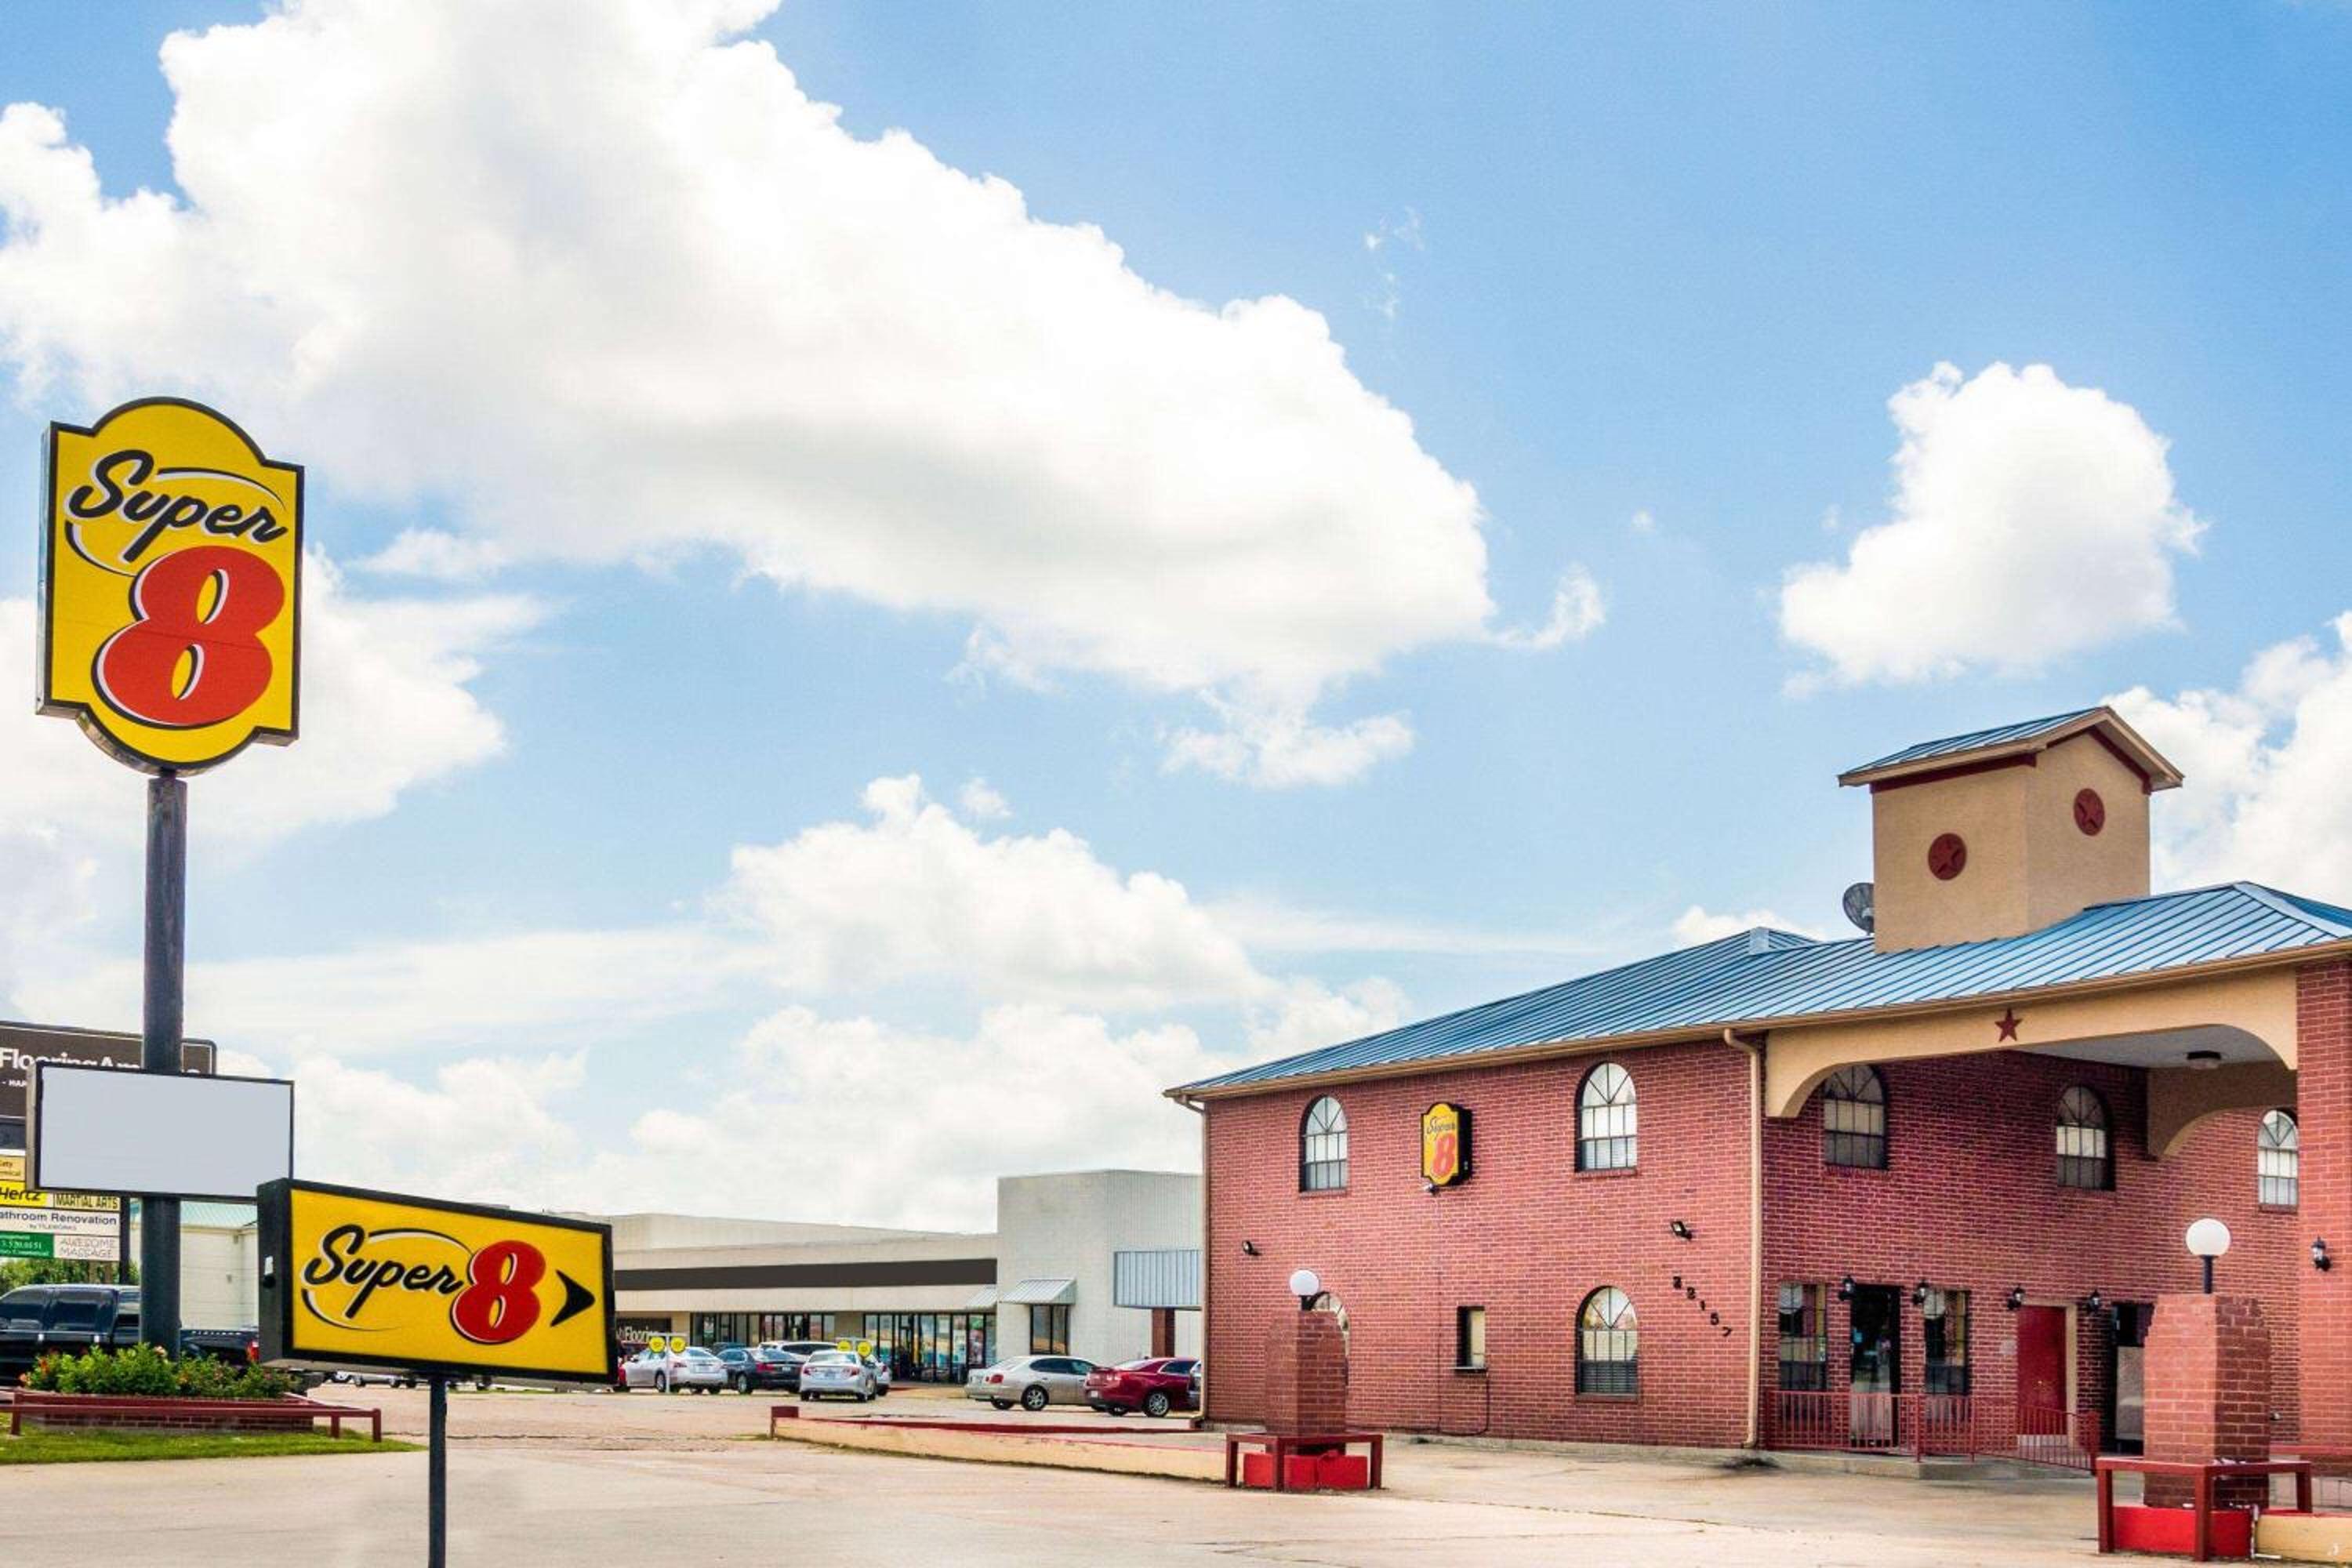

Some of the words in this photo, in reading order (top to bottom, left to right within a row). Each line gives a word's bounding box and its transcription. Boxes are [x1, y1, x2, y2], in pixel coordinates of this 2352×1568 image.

[67, 449, 287, 563] Super
[91, 545, 285, 730] 8
[1430, 1131, 1456, 1178] 8
[0, 1210, 47, 1221] athroom
[51, 1213, 117, 1225] Renovation
[302, 1225, 463, 1319] Super
[449, 1239, 546, 1345] 8
